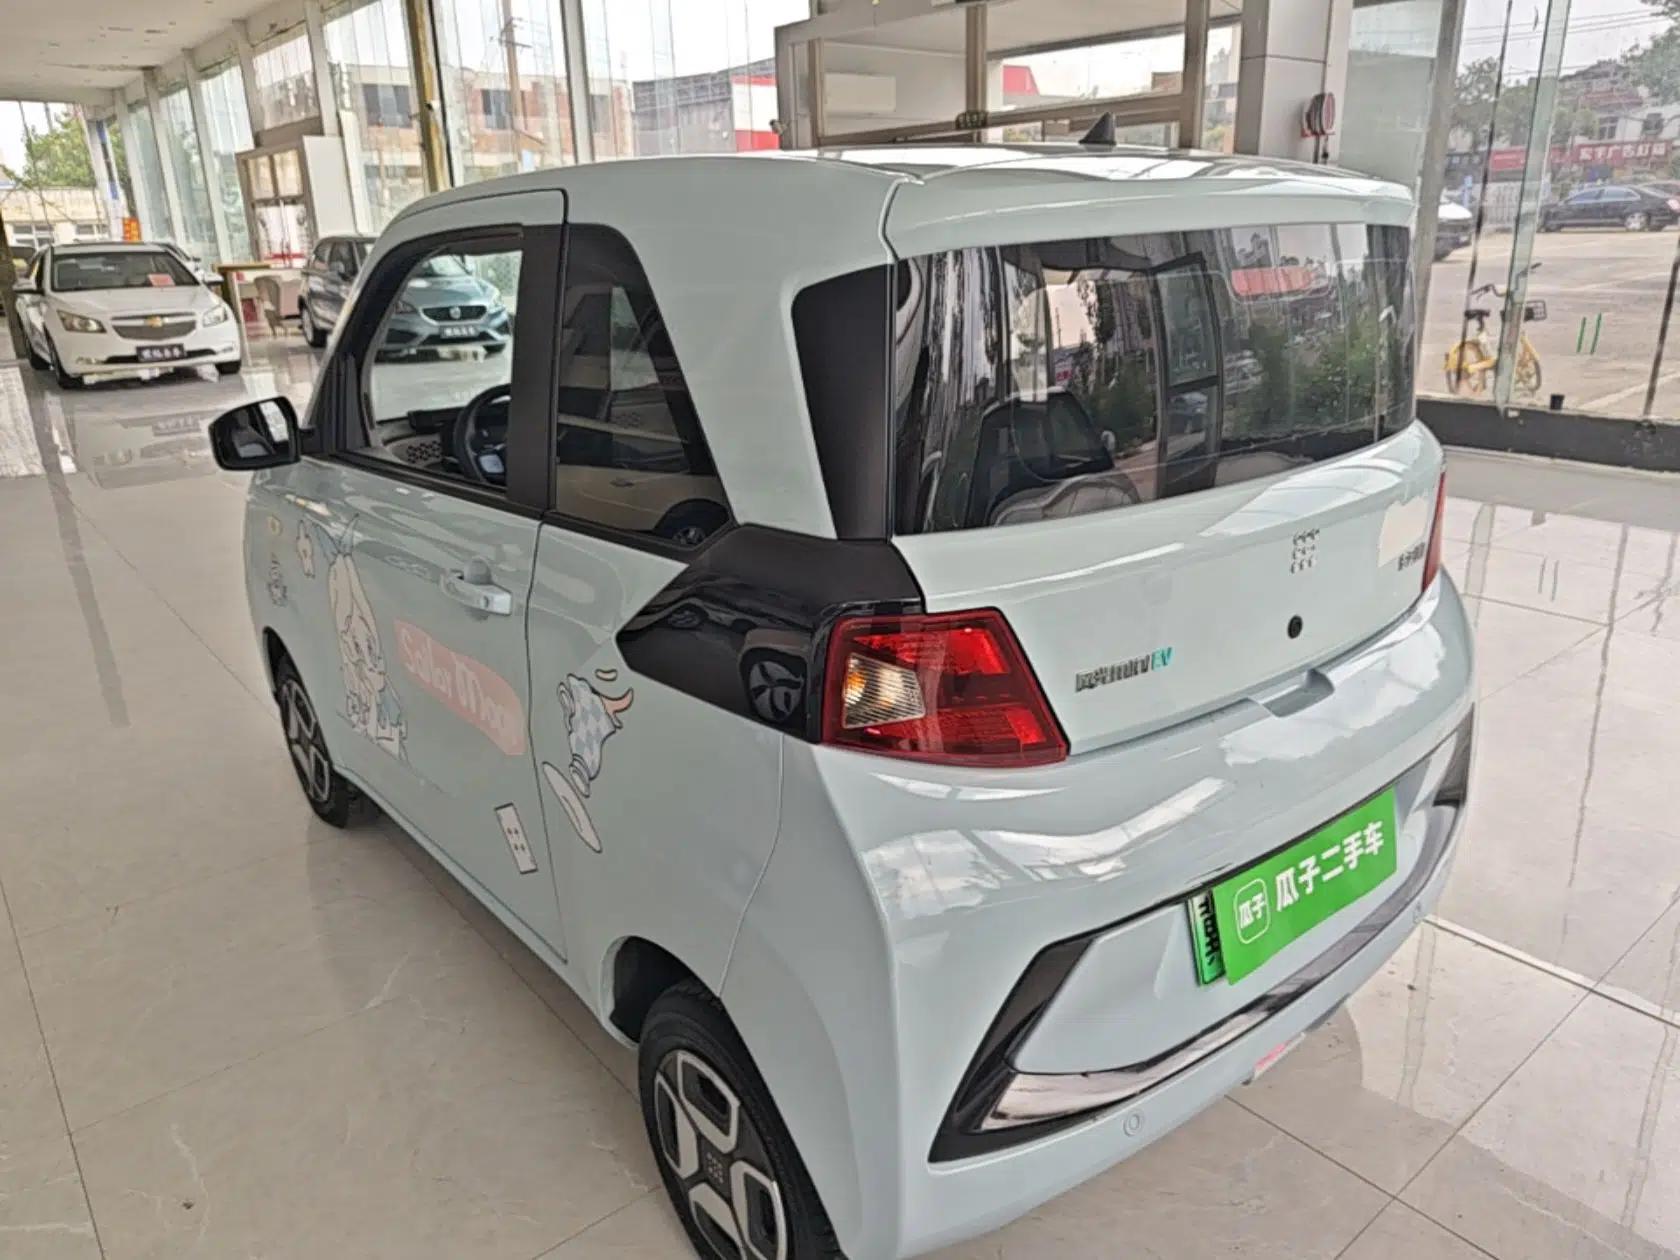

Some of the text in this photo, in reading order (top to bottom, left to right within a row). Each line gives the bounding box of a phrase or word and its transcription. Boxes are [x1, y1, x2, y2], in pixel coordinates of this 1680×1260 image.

[1275, 821, 1384, 912] 瓜子二手车
[1238, 892, 1266, 929] 瓜子
